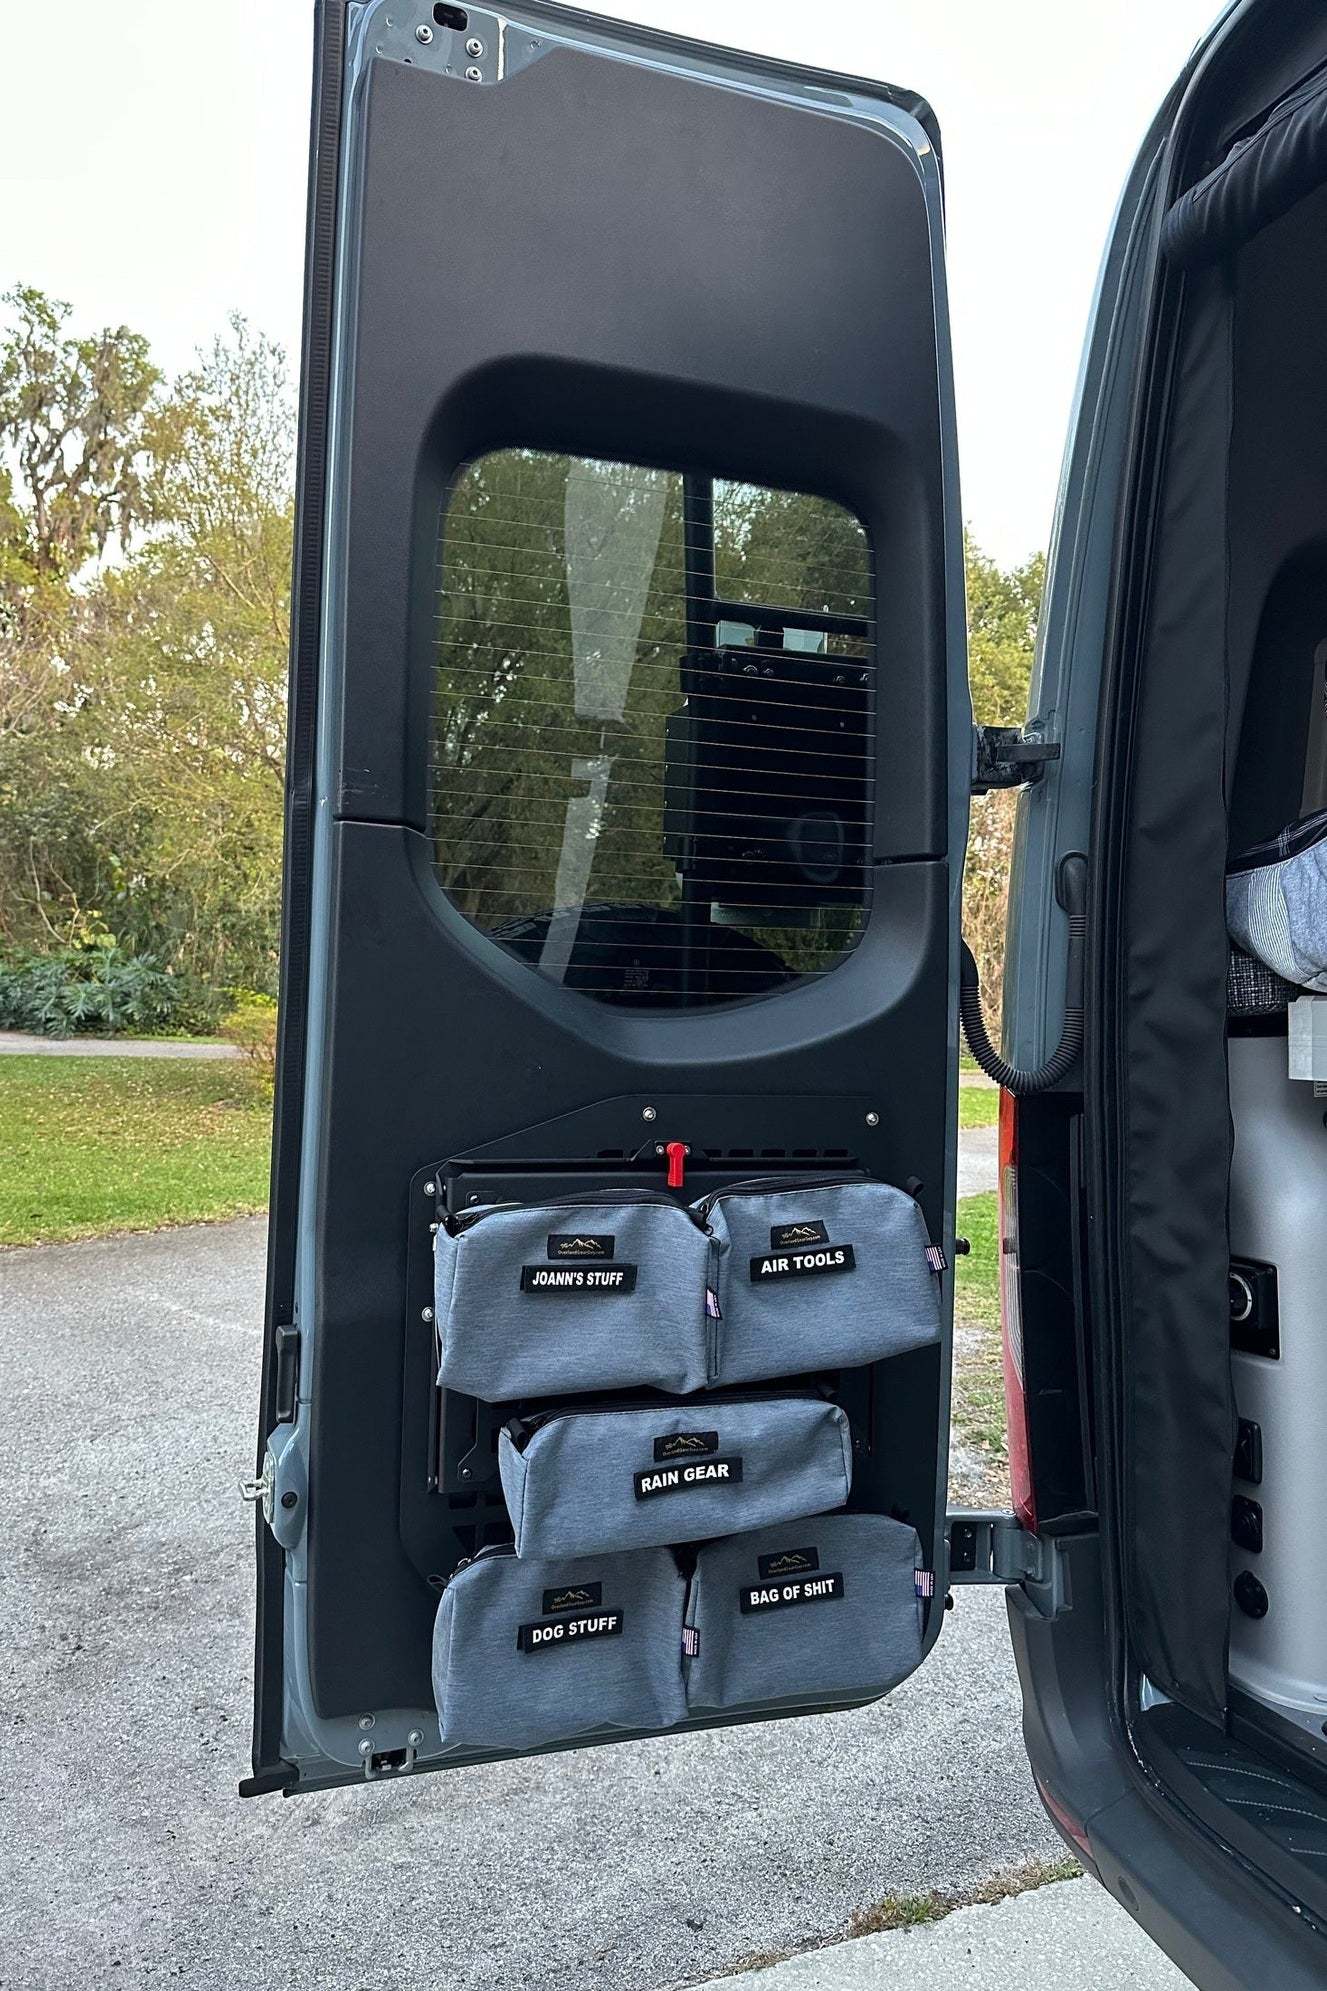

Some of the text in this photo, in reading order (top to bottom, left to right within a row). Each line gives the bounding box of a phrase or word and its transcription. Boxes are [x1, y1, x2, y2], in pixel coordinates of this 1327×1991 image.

[760, 1250, 845, 1274] AIR TOOLS
[533, 1271, 624, 1286] JOANN'S STUFF
[641, 1463, 730, 1493] RAIN GEAR
[750, 1579, 835, 1605] BAG OF SHIT
[532, 1616, 617, 1644] DOG STUFF
